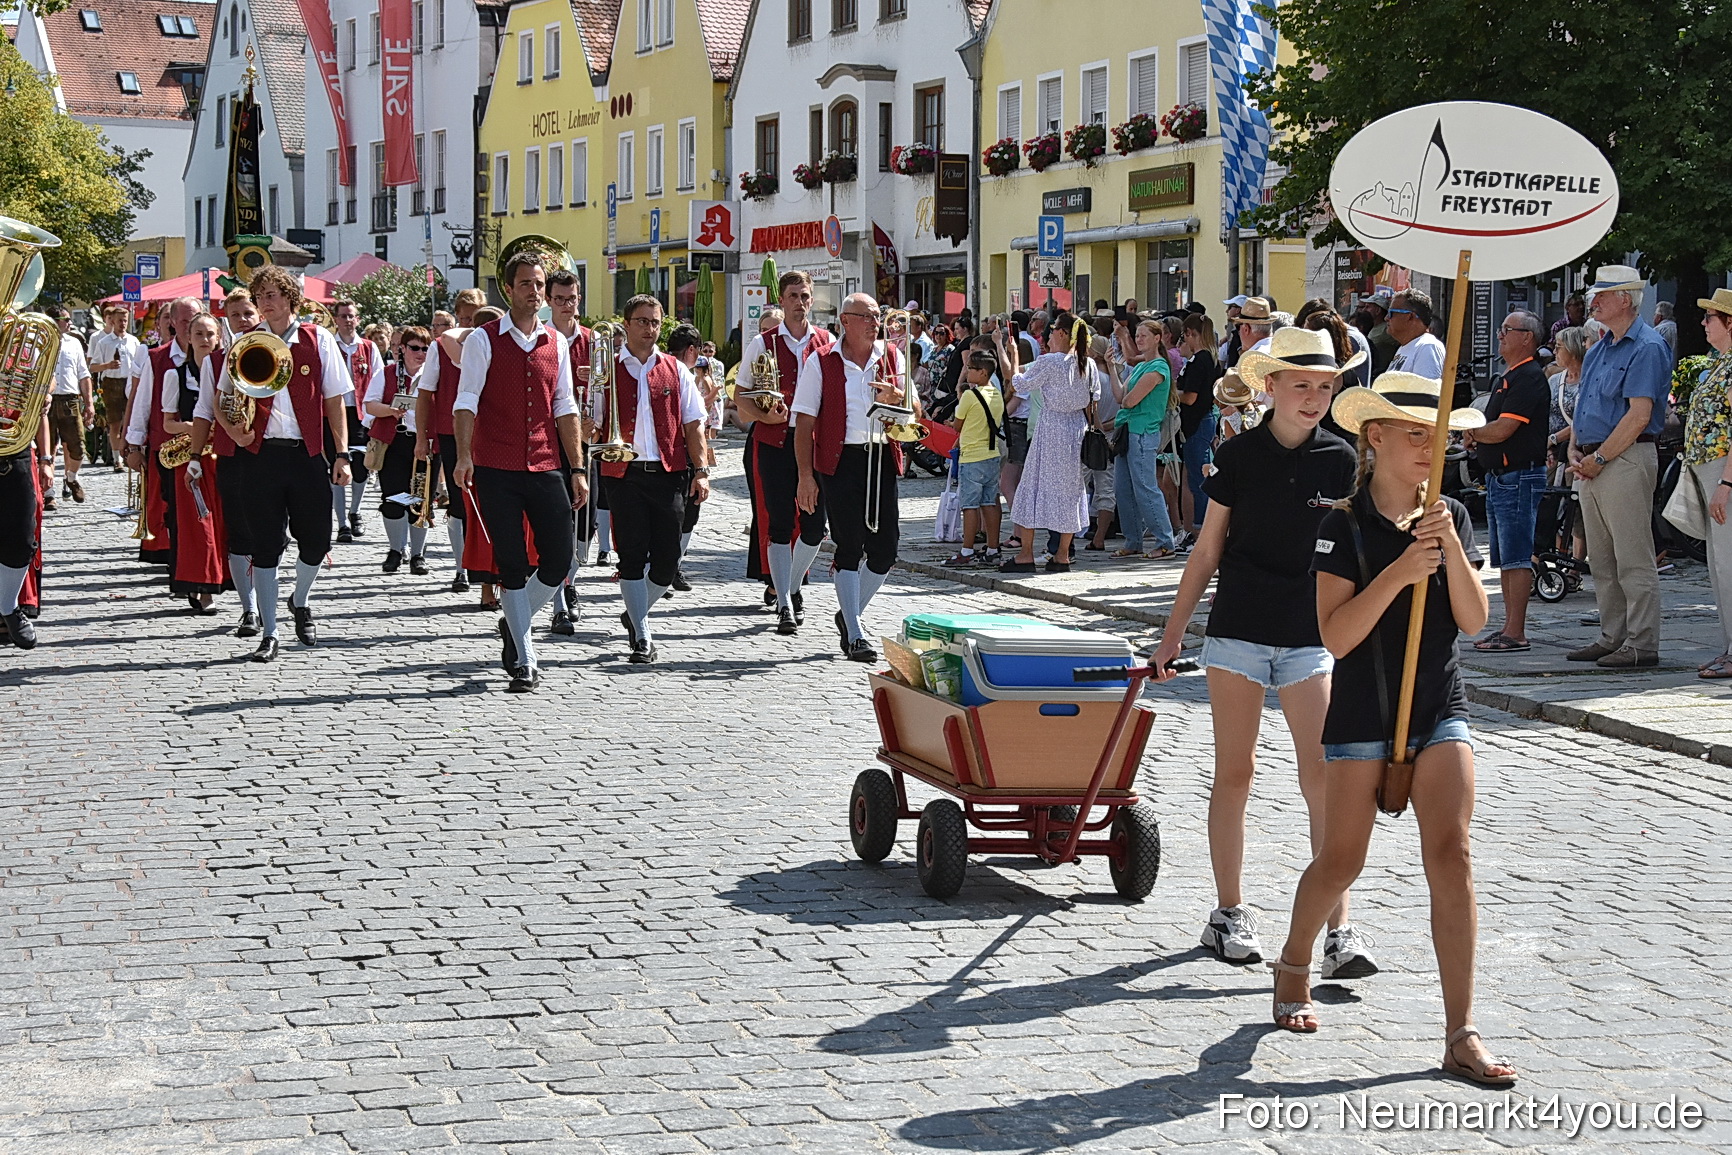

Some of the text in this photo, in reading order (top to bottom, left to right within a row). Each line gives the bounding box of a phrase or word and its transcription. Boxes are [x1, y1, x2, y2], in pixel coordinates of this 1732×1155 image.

[532, 106, 601, 138] HOTEL Lehmeier
[1130, 176, 1185, 199] NATURHAUTNAH
[1451, 169, 1601, 194] STADTKAPELLE
[609, 188, 615, 215] P
[1044, 196, 1062, 210] WOLLE
[1067, 194, 1083, 207] MEHR
[1441, 195, 1553, 217] FREYSTADT
[652, 213, 659, 241] P
[750, 221, 821, 253] APOTHEKE
[1044, 221, 1059, 252] P
[1337, 256, 1351, 267] Mein
[1337, 268, 1363, 280] Reisebüro
[125, 292, 140, 300] TAXI
[1555, 559, 1575, 568] ATHLON
